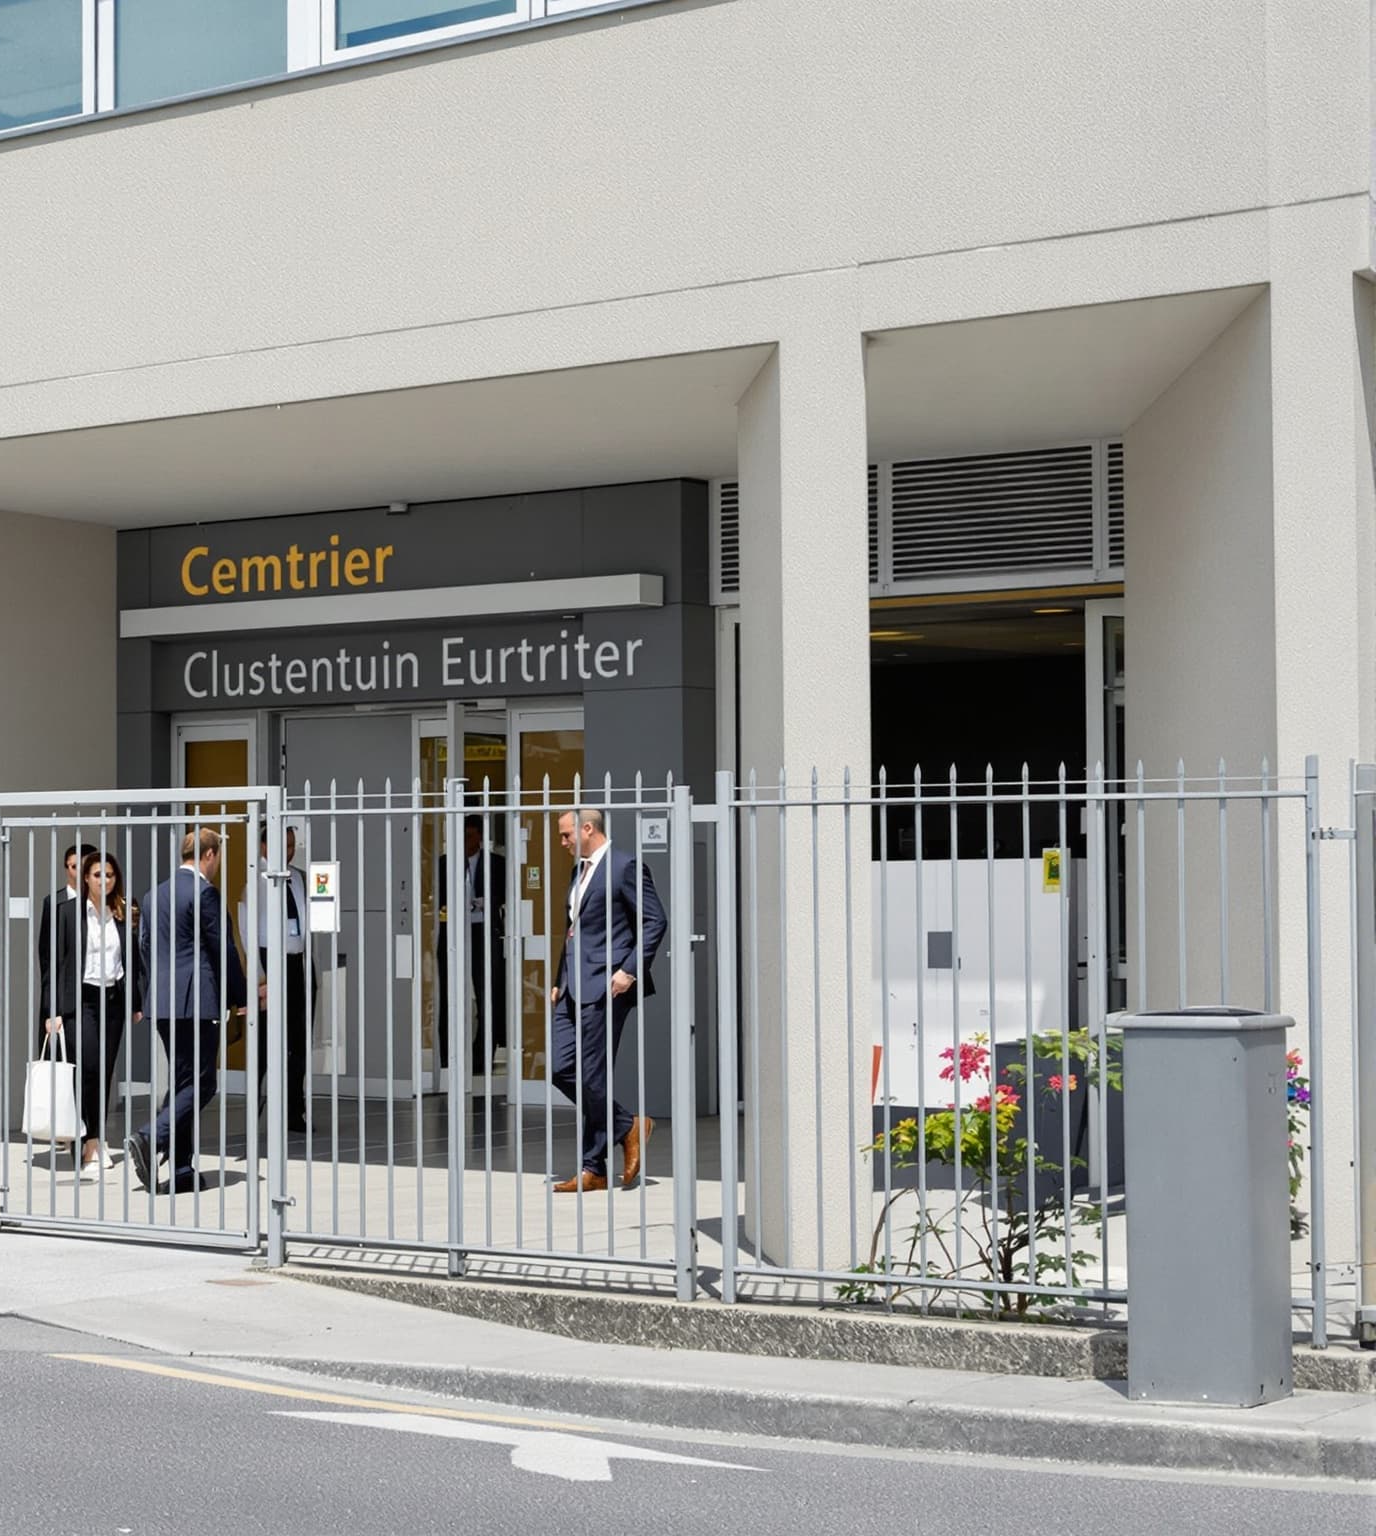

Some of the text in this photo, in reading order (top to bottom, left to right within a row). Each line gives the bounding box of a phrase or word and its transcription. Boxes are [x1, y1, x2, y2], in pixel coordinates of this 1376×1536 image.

[180, 534, 394, 597] Cemtrier
[184, 630, 643, 698] Clustentuin Eurtriter
